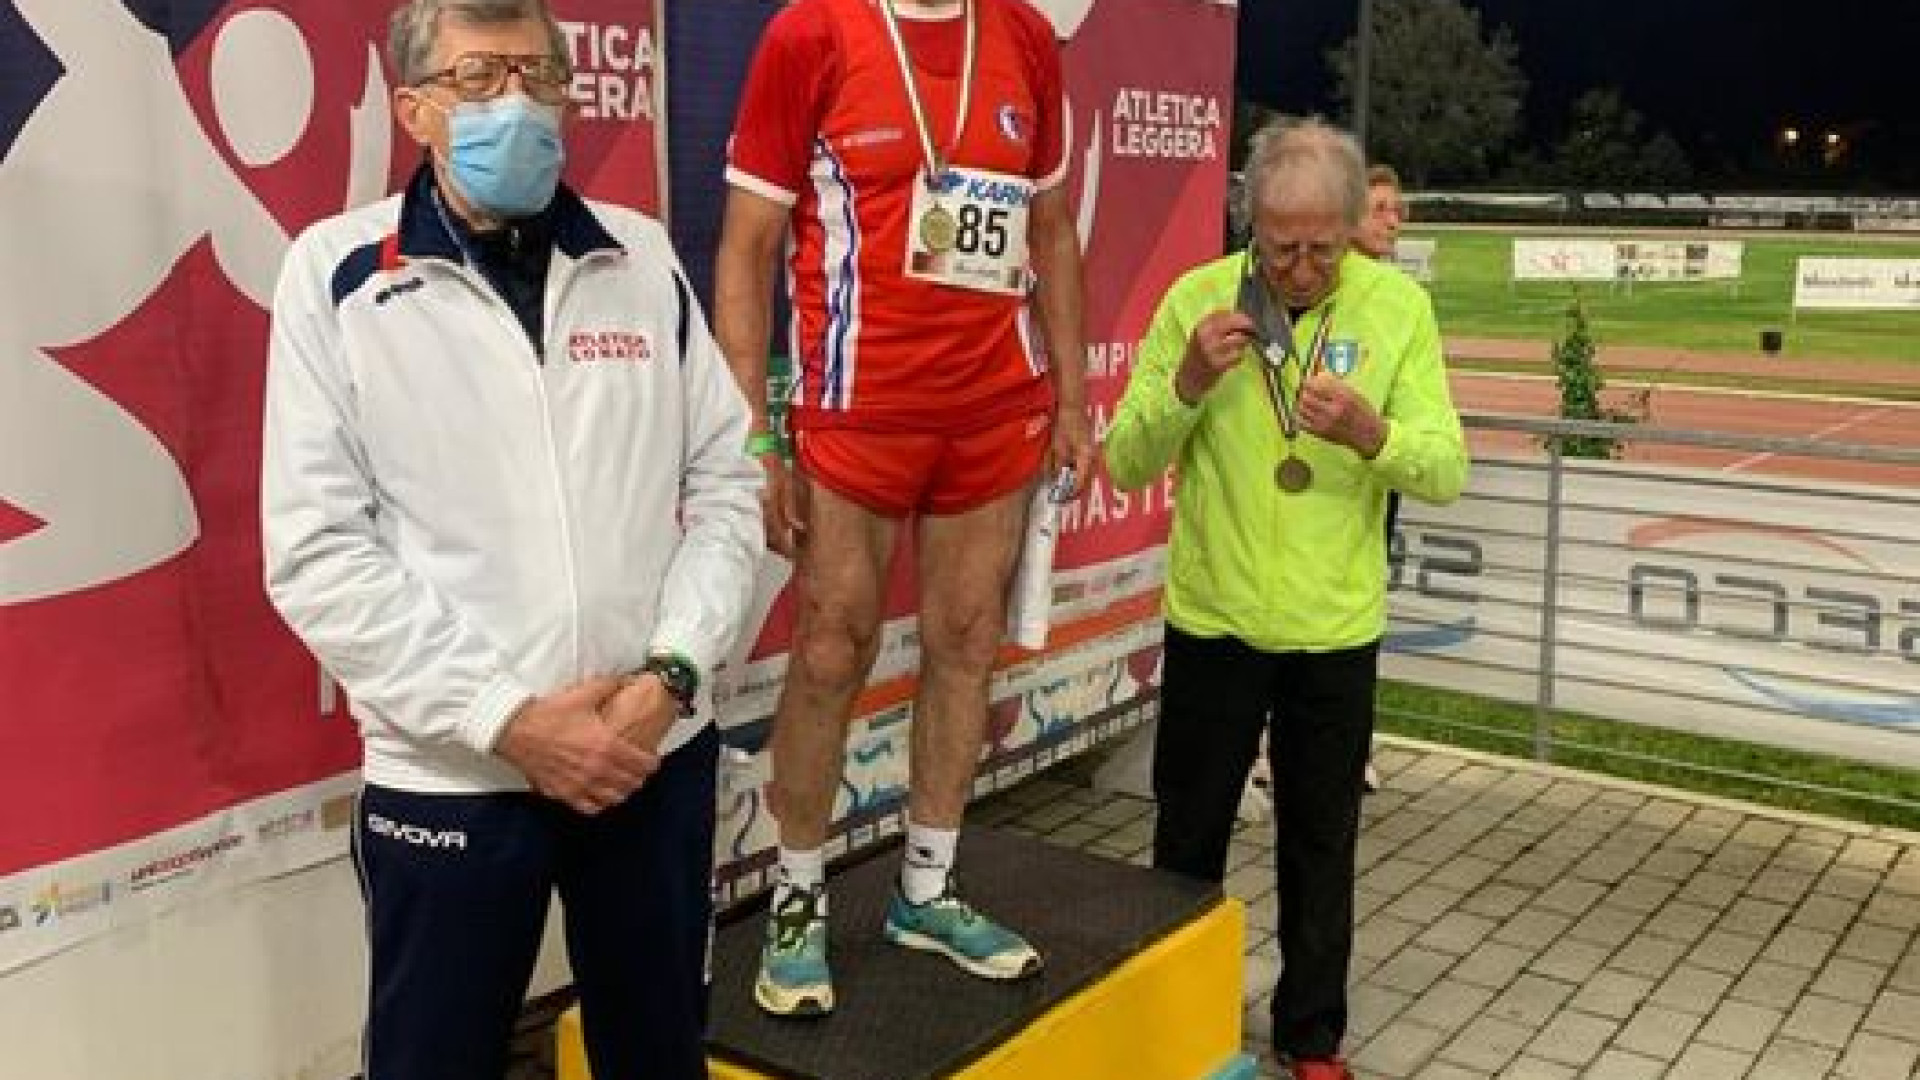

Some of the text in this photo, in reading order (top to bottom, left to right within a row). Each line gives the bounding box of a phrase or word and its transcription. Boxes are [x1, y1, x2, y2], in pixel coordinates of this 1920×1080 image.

[1112, 87, 1220, 129] ATLETICA
[1112, 123, 1217, 161] LEGGERA
[955, 203, 1009, 257] 85
